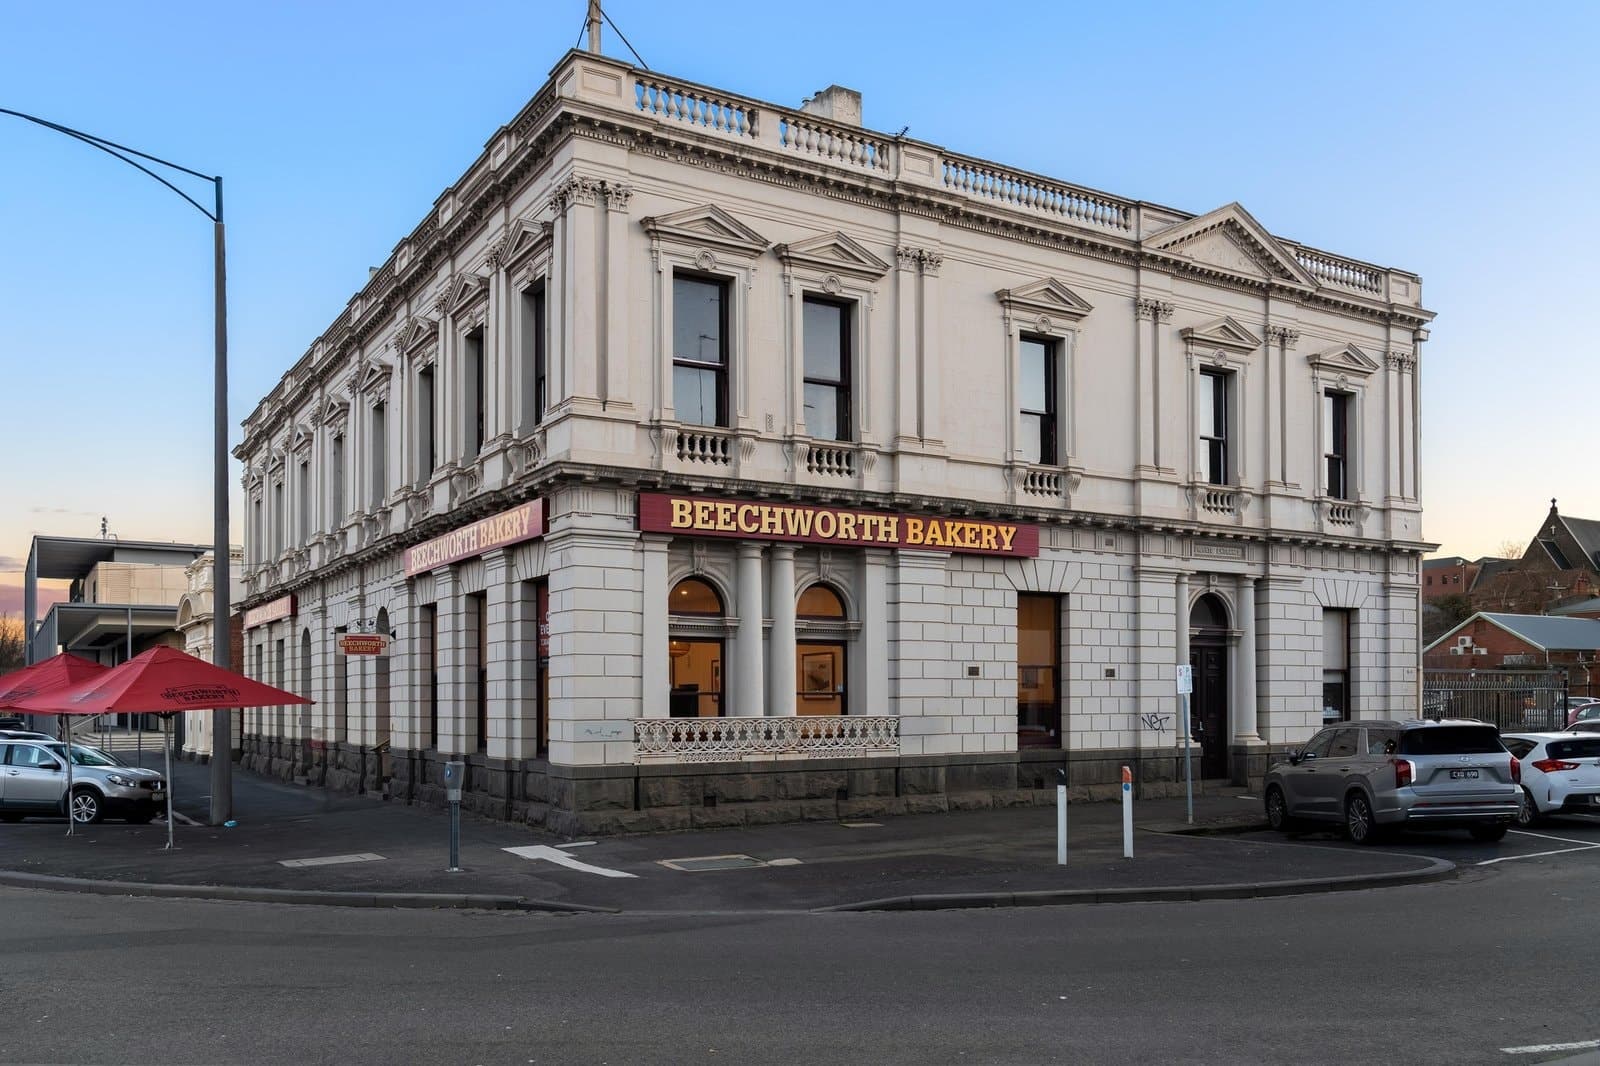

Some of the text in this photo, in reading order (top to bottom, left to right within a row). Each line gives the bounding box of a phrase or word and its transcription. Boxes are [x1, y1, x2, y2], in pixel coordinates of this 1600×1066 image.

[411, 507, 530, 571] BEECHWORTH BAKERY
[671, 499, 1017, 551] BEECHWORTH BAKERY
[339, 640, 386, 648] BEECHWORTH
